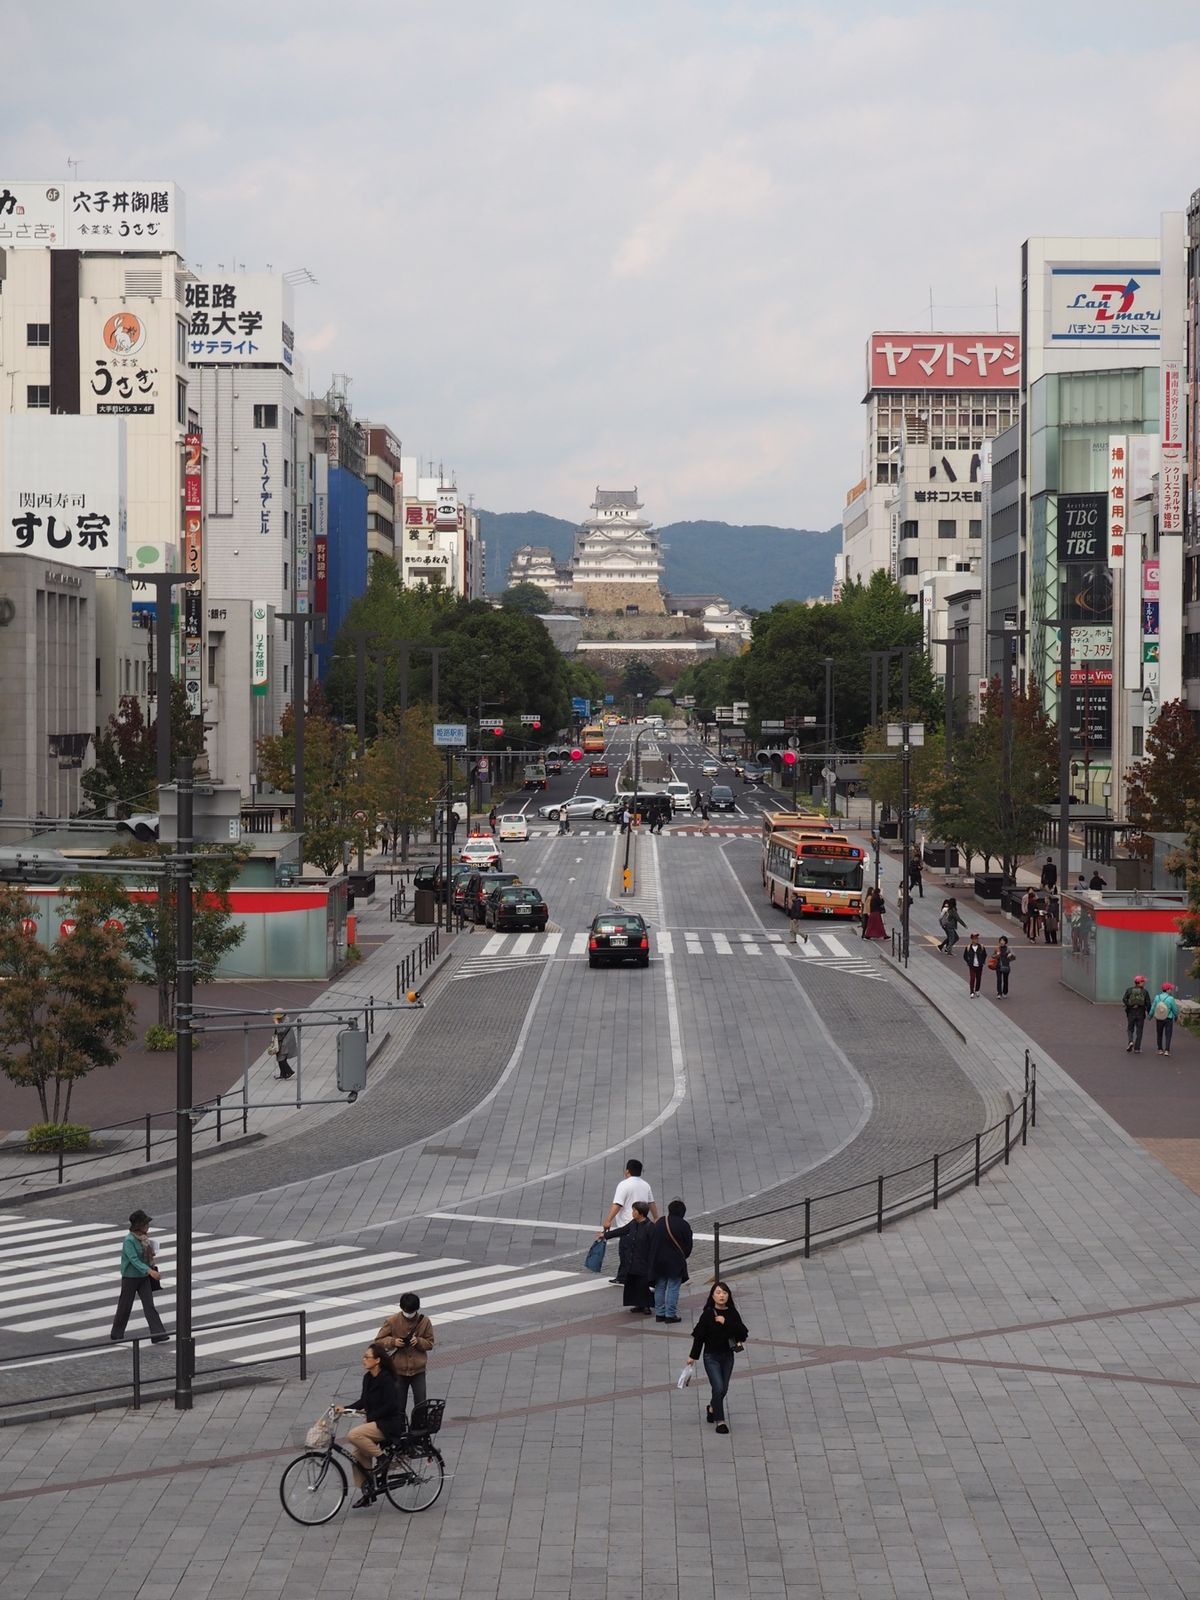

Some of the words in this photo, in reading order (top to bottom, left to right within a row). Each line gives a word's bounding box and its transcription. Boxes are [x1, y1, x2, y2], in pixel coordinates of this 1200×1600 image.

[48, 190, 59, 200] 6F
[73, 191, 169, 214] 穴子丼御膳
[78, 224, 113, 235] 食菜家
[119, 221, 160, 237] うさぎ
[185, 283, 237, 309] 姫路
[90, 360, 158, 399] うさぎ
[1171, 371, 1179, 441] 湘南美容クリニック
[20, 492, 85, 508] 関西寿司
[260, 442, 273, 534] しらさぎビル
[1173, 466, 1181, 529] クリニカルサロン
[1111, 447, 1124, 557] 播州信用金庫
[1066, 509, 1098, 526] TBC
[12, 512, 110, 551] すし宗
[1071, 530, 1092, 539] MEN'S
[1067, 539, 1097, 555] TBC
[256, 635, 264, 677] りそな銀行
[436, 728, 464, 737] 姫路駅前
